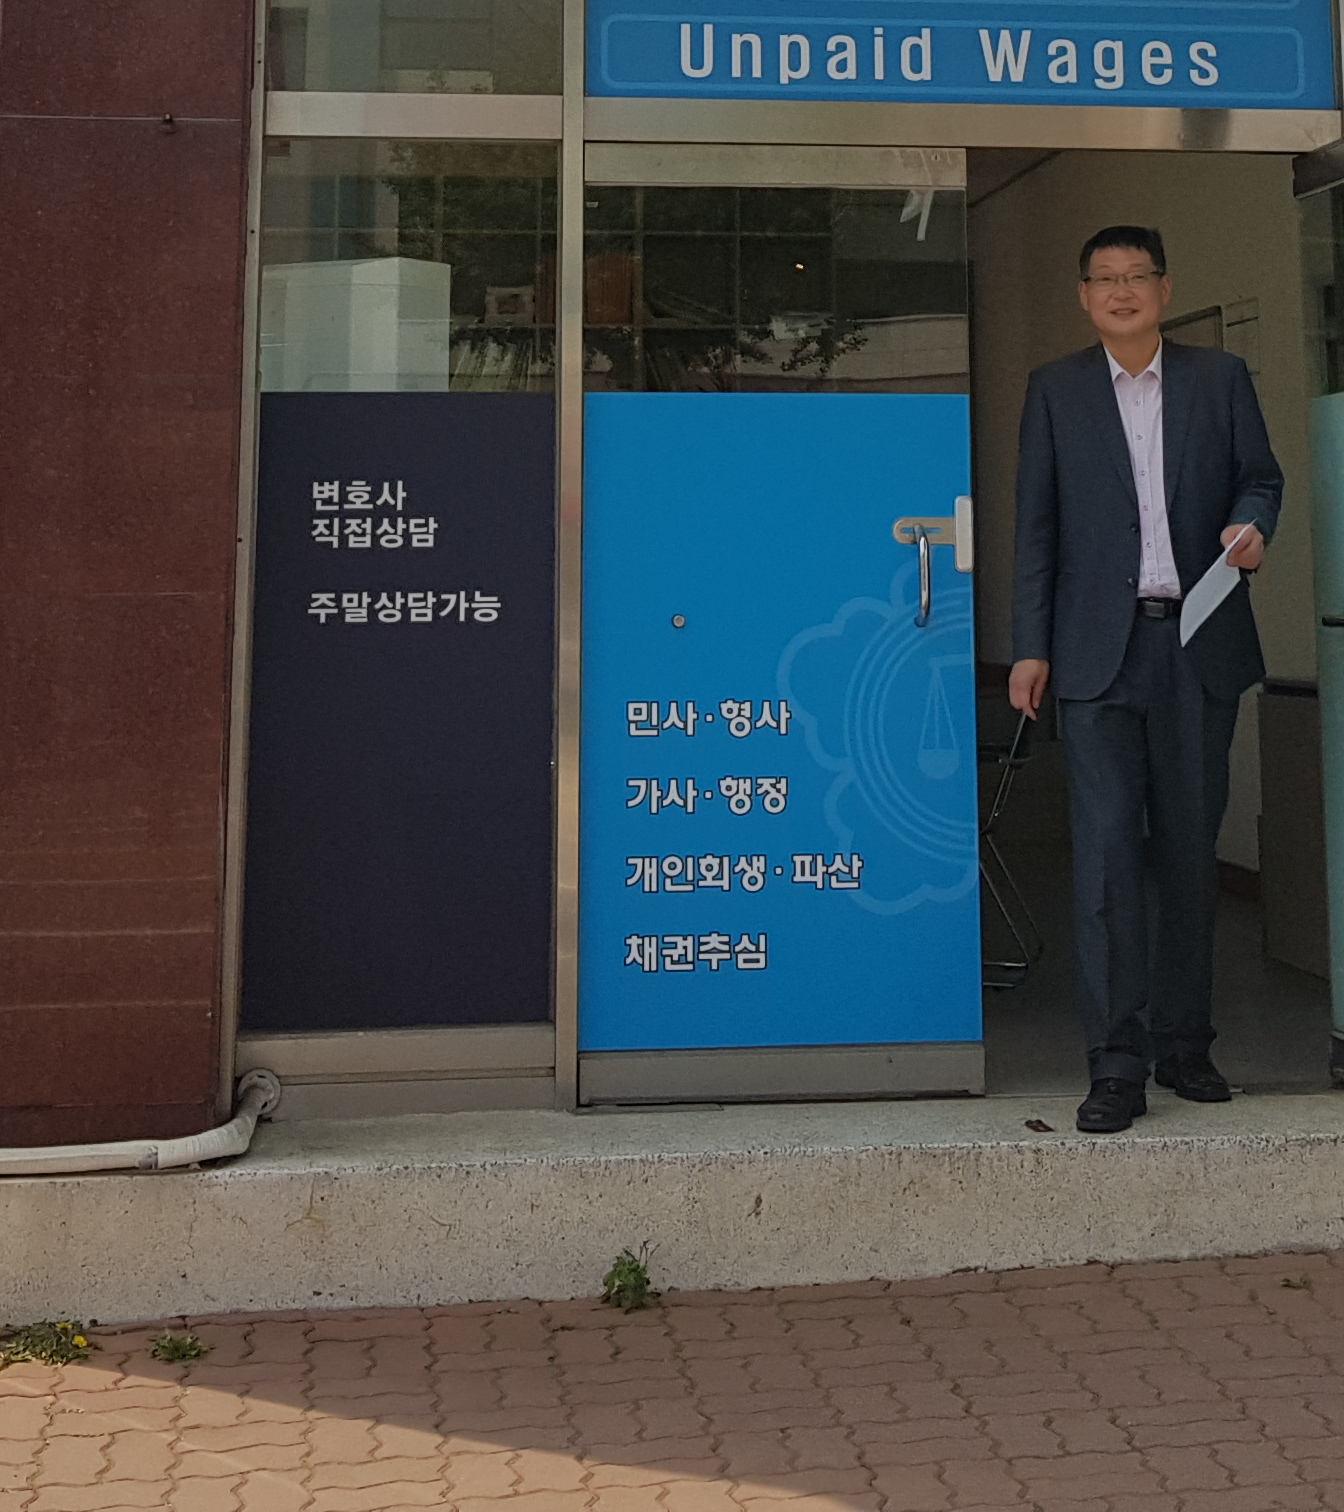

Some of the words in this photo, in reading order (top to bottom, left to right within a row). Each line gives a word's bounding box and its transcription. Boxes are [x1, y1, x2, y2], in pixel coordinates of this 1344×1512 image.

[680, 23, 932, 85] Unpaid
[978, 28, 1220, 90] Wages
[312, 480, 407, 511] 변호사
[311, 516, 439, 549] 직접상담
[307, 590, 502, 624] 주말상담가능
[625, 933, 767, 972] 채권추심
